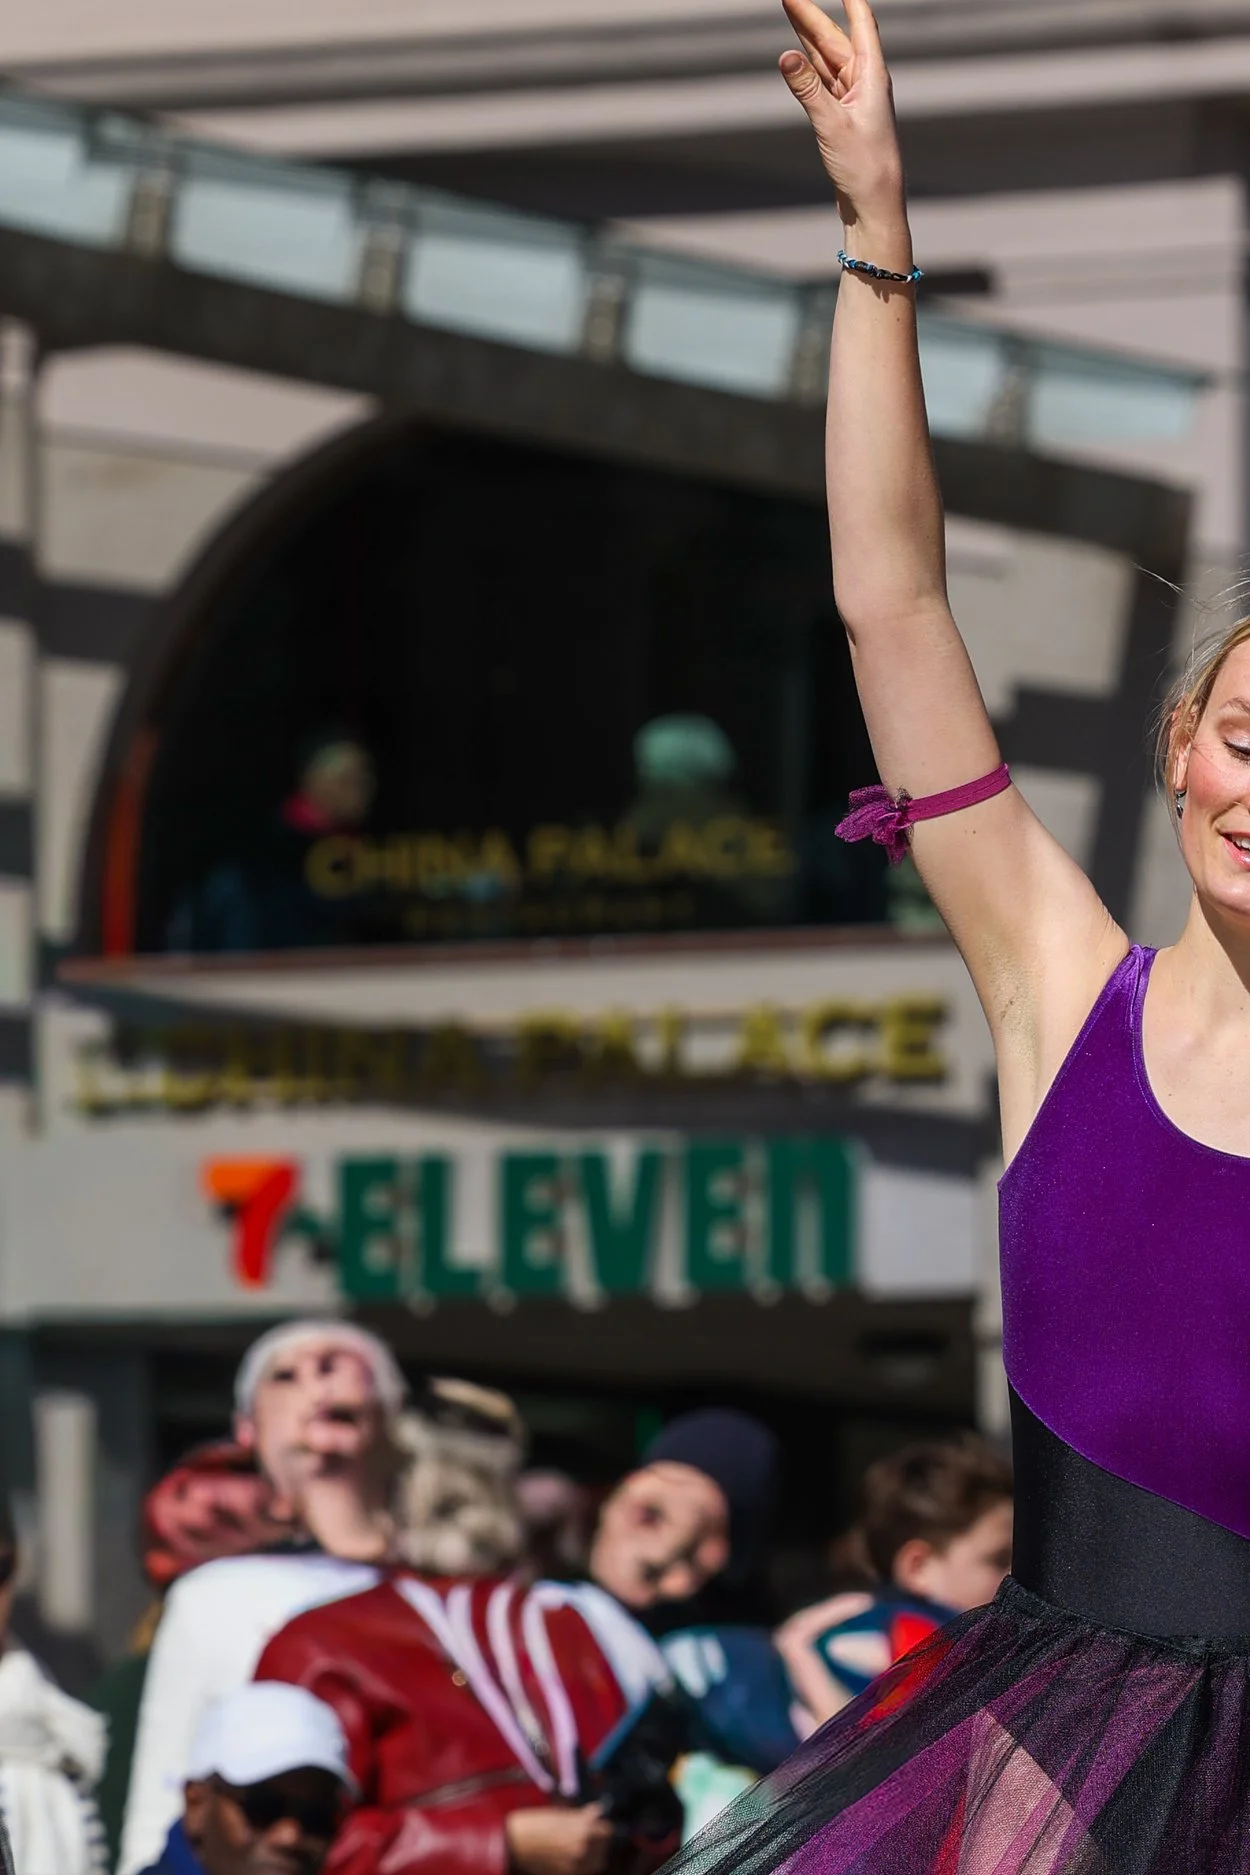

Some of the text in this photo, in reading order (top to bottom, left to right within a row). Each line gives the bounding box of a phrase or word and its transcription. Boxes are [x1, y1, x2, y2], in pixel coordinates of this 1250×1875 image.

[305, 816, 794, 897] CHINA PALACE
[515, 996, 950, 1094] PALACE
